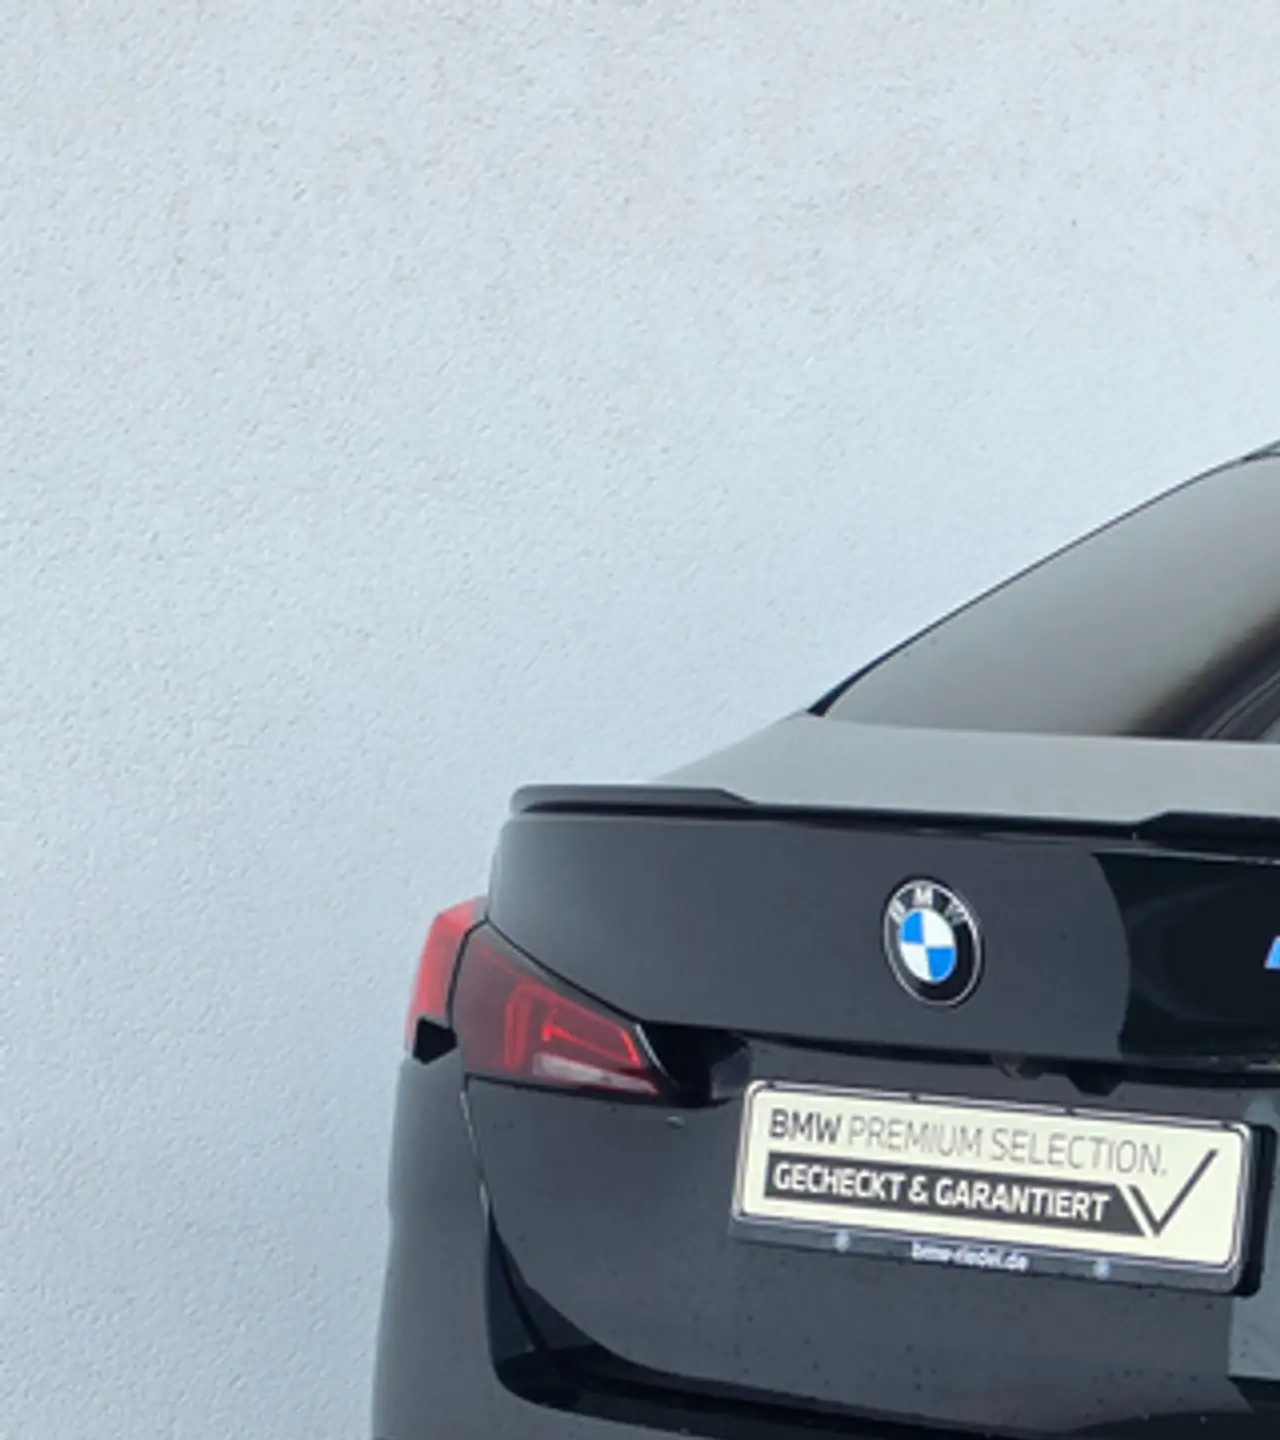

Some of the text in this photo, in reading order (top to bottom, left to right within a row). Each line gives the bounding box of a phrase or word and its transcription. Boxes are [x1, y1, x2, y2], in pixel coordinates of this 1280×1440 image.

[769, 1108, 1169, 1176] BMW PREMIUM SELECTION.
[773, 1161, 1110, 1223] GECHECKT & GARANTIERT
